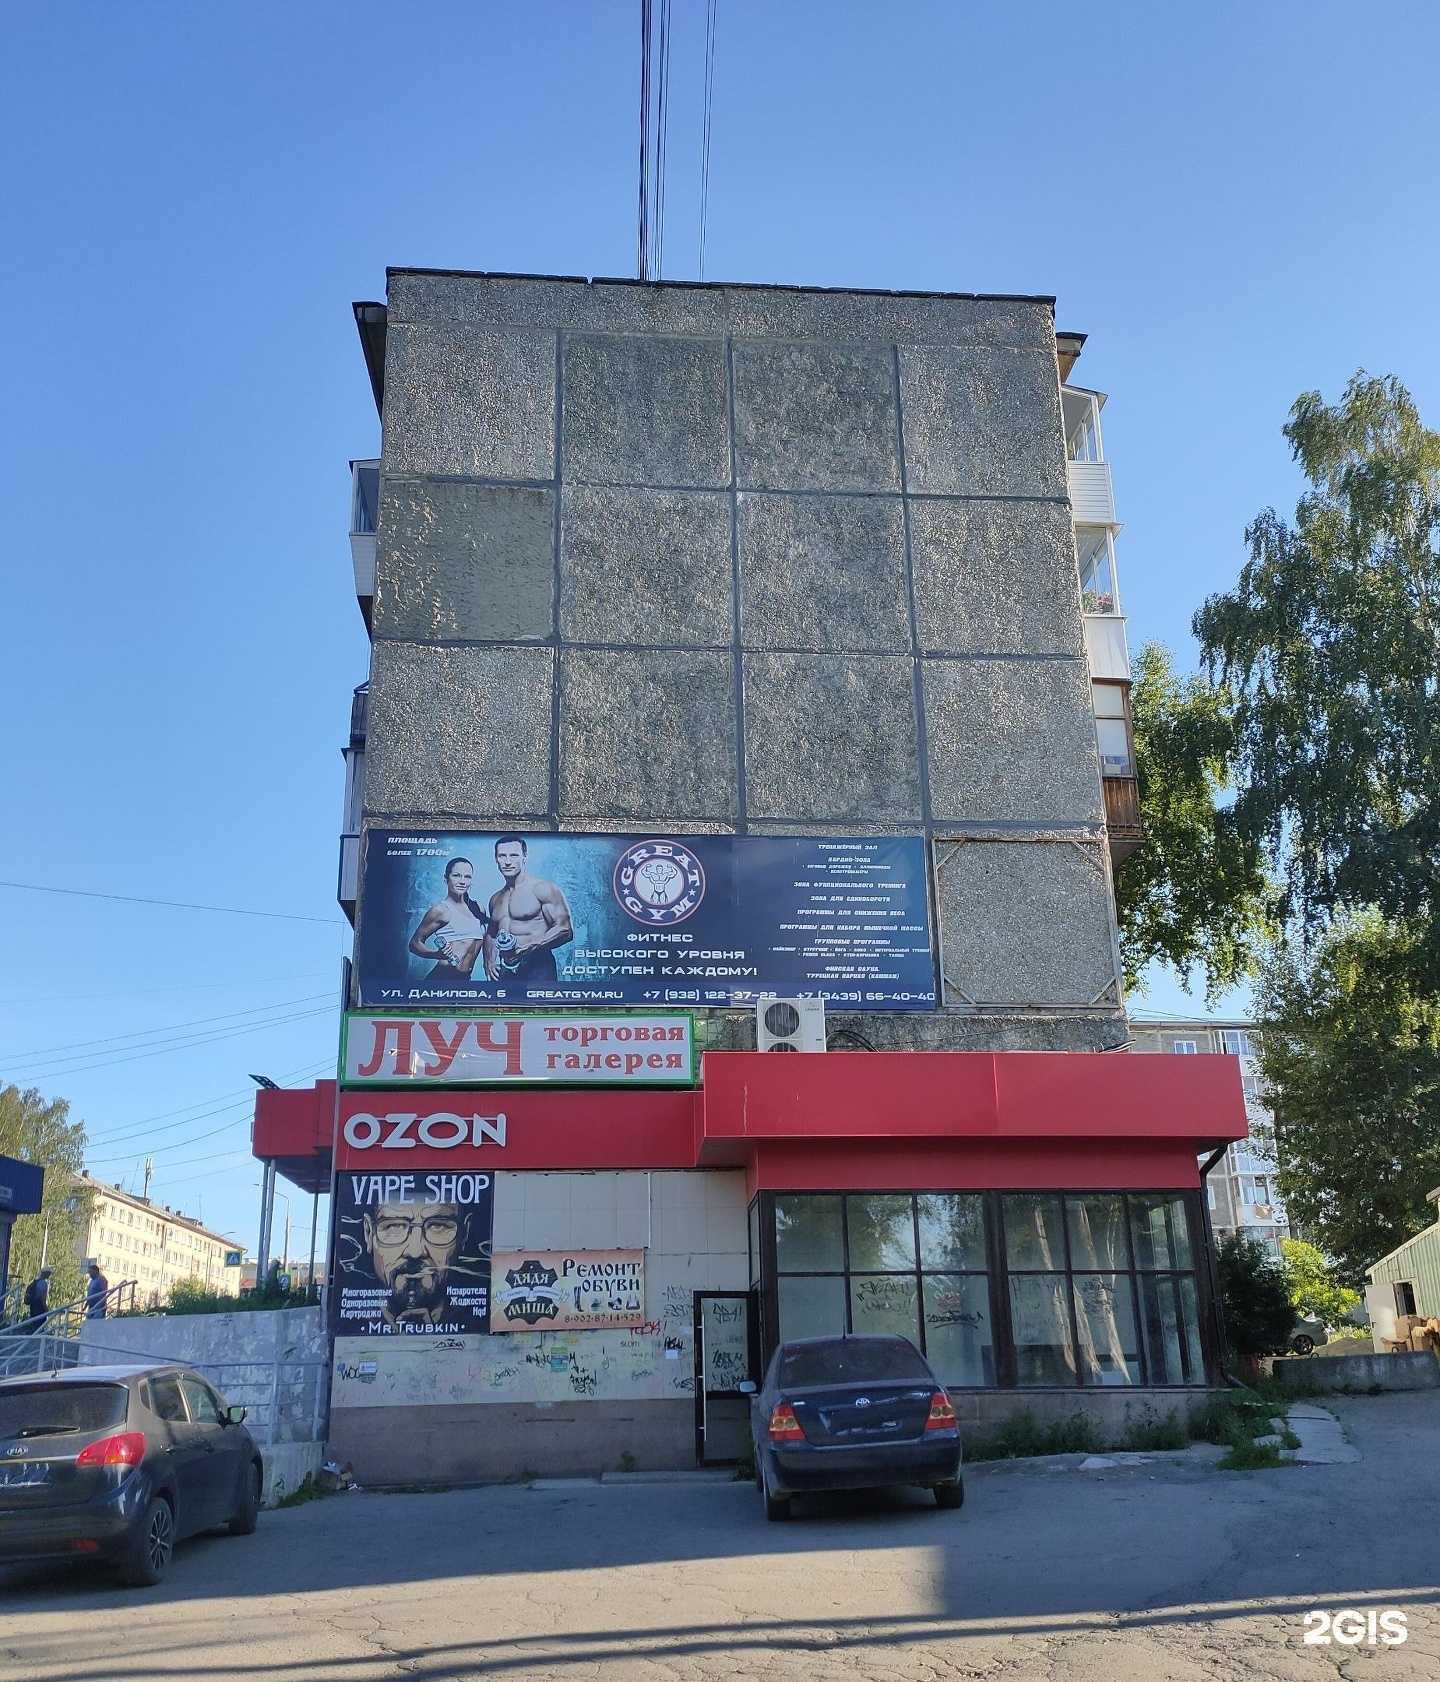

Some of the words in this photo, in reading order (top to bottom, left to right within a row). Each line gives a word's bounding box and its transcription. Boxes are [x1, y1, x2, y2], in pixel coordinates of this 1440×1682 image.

[621, 845, 700, 886] GREAT
[625, 896, 694, 920] GYM
[627, 934, 694, 943] ФИТНЕС
[575, 950, 669, 959] ВЫСОКОГО
[677, 951, 745, 960] УРОВНЯ
[562, 966, 654, 976] ДОСТУПЕН
[661, 966, 758, 977] КАЖДОМУ!
[381, 990, 403, 998] УЛ.
[408, 989, 492, 999] ДАНИЛОВА,
[526, 990, 624, 999] GREATGYM.RU
[643, 991, 661, 999] +7
[665, 989, 700, 1001] (932)
[704, 991, 777, 999] 122-37-22
[818, 990, 862, 1002] (3439)
[866, 992, 935, 1000] 66-40-40
[358, 1021, 525, 1077] ЛУЧ
[544, 1025, 684, 1048] торговая
[546, 1052, 683, 1075] галерея
[343, 1112, 507, 1149] OZON
[351, 1175, 416, 1205] VAPE
[425, 1174, 490, 1205] SHOP
